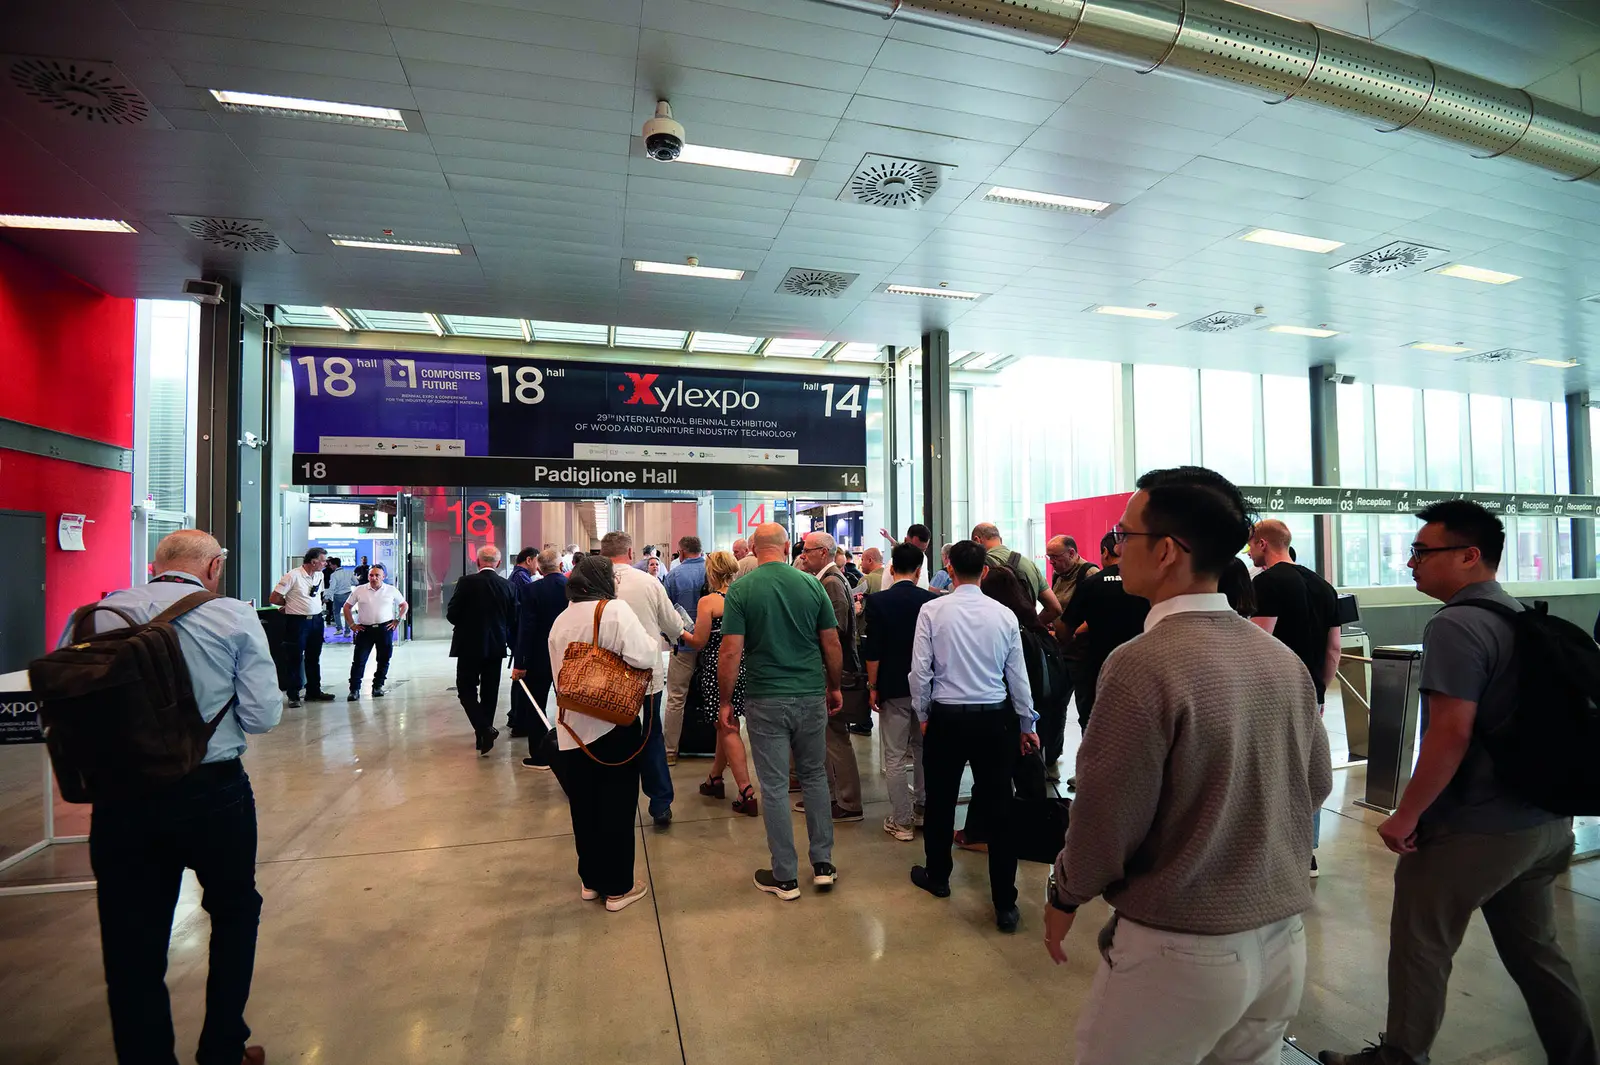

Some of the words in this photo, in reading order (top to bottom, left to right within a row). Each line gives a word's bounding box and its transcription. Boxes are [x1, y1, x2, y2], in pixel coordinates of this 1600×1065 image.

[297, 356, 357, 397] 18
[357, 359, 377, 368] hall
[421, 369, 481, 381] COMPOSITES
[422, 381, 458, 391] FUTURE
[492, 365, 545, 405] 18
[546, 368, 565, 377] hall
[623, 372, 760, 414] Xylexpo
[803, 382, 819, 391] hall
[820, 383, 862, 418] 14
[575, 423, 588, 431] OF
[590, 423, 621, 432] WOOD
[623, 425, 643, 433] AND
[645, 425, 694, 435] FURNITURE
[696, 427, 738, 437] INDUSTRY
[740, 429, 797, 438] TECHNOLOGY
[597, 414, 615, 422] 29TH
[616, 415, 687, 425] INTERNATIONAL
[689, 417, 729, 427] BIENNIAL
[730, 419, 778, 428] EXHIBITION
[301, 462, 327, 479] 18
[534, 466, 636, 487] Padiglione
[642, 467, 678, 484] Hall
[841, 473, 860, 486] 14
[1270, 499, 1284, 510] 02
[1294, 495, 1332, 505] Reception
[1340, 499, 1353, 510] 03
[1357, 497, 1391, 506] Reception
[1397, 501, 1409, 512] 04
[1505, 504, 1516, 514] 06
[1522, 501, 1549, 510] Reception
[1554, 505, 1563, 514] 07
[1566, 502, 1592, 511] Reception
[447, 500, 492, 536] 18
[729, 503, 765, 535] 14
[0, 701, 38, 717] xpo
